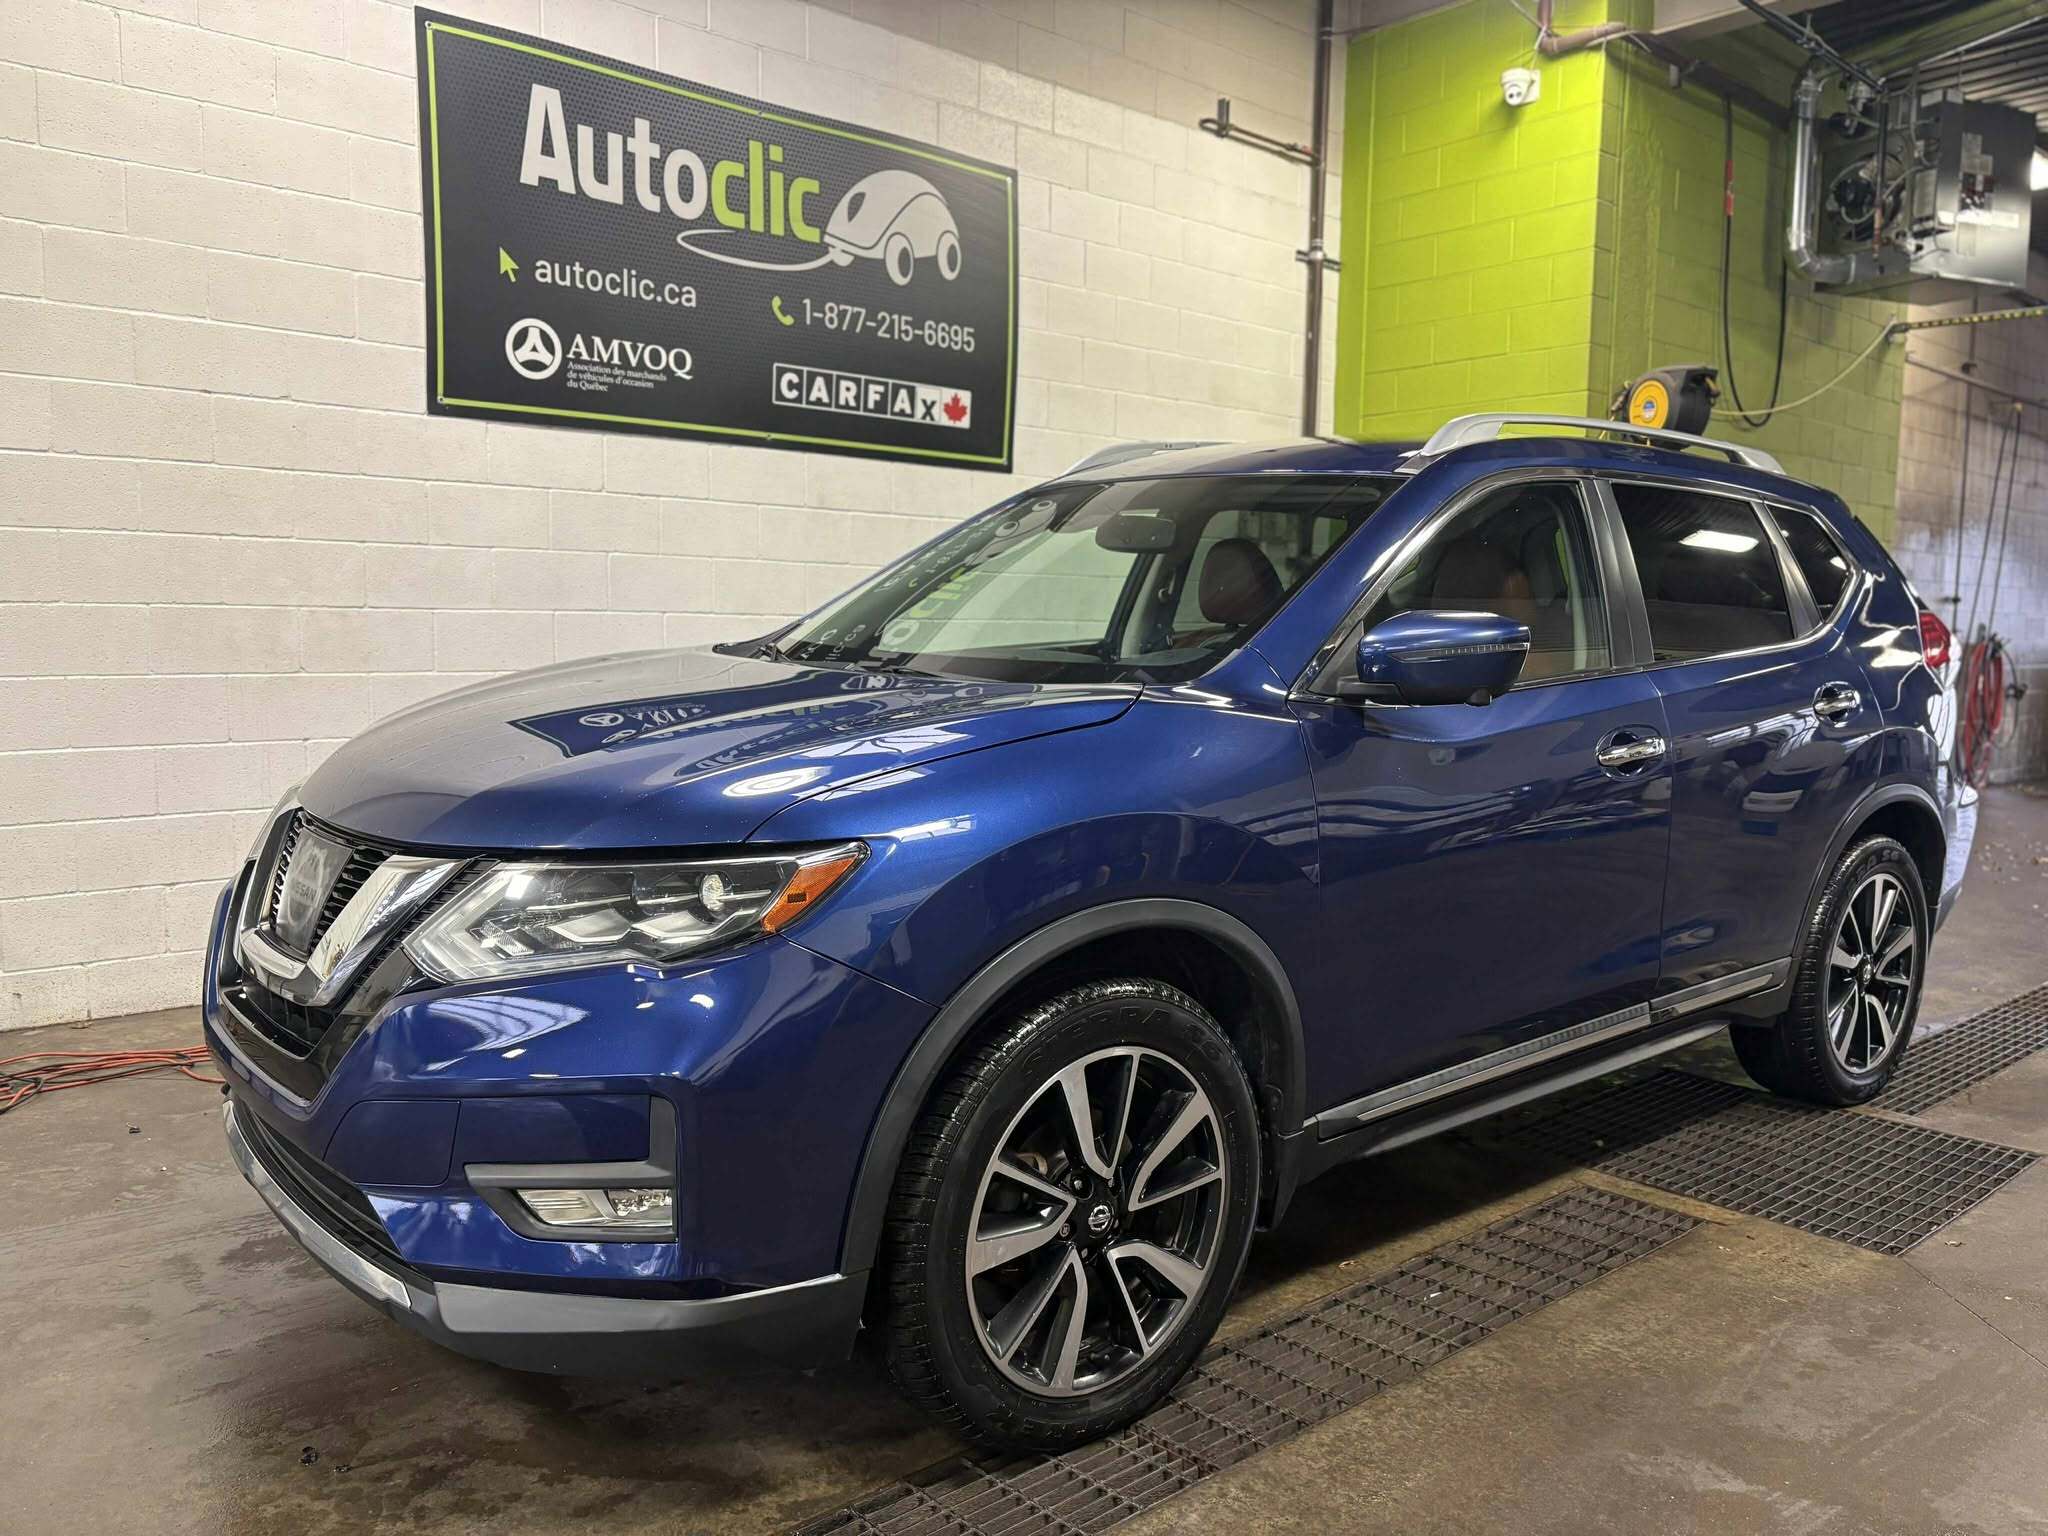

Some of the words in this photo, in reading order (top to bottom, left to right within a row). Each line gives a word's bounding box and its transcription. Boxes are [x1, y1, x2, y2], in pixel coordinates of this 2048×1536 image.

[519, 82, 821, 245] Autoclic
[534, 257, 698, 308] autoclic.ca
[802, 297, 976, 353] 1-877-215-6695
[566, 333, 694, 380] AMVOQ
[567, 361, 610, 374] Association
[612, 367, 625, 376] des
[626, 370, 667, 381] marchands
[567, 370, 577, 379] de
[579, 371, 613, 383] véhicules
[567, 379, 578, 389] du
[579, 380, 608, 391] Québec
[779, 370, 939, 423] CARFAX
